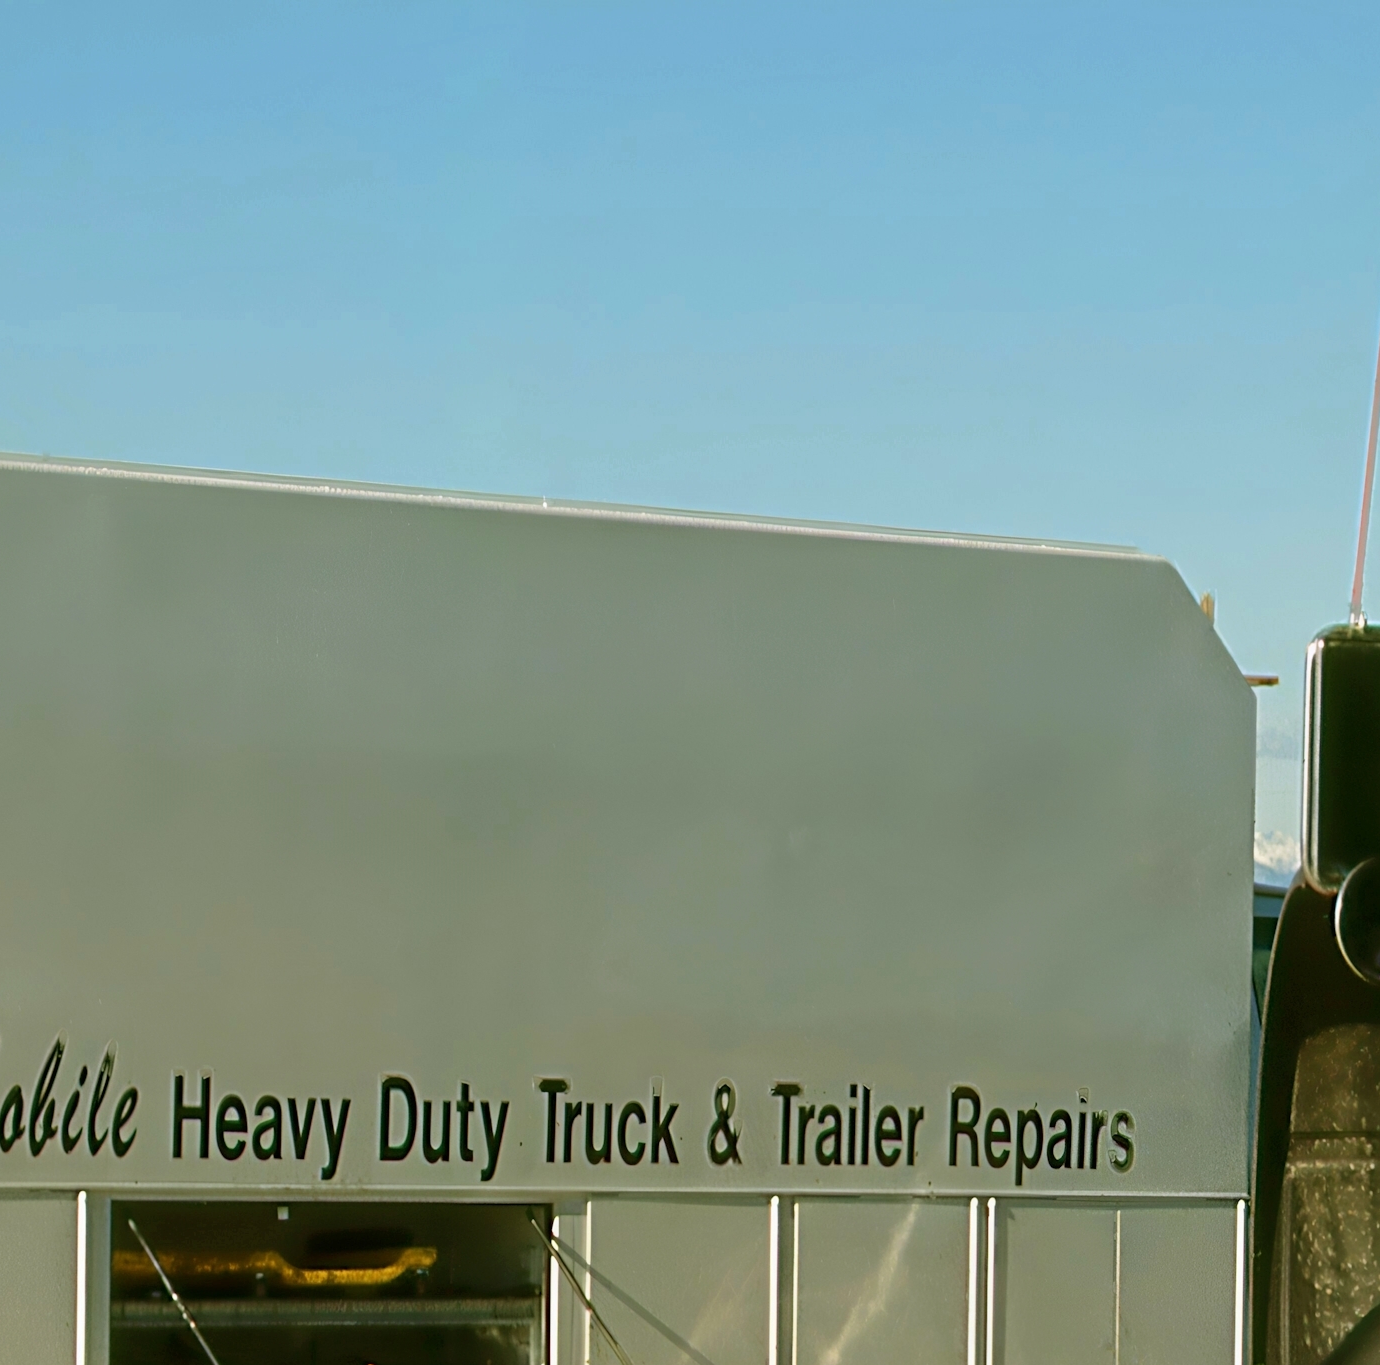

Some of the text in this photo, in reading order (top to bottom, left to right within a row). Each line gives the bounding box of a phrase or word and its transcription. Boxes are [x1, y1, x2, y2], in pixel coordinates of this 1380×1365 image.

[171, 1069, 351, 1181] Heavy
[379, 1074, 510, 1182] Duty
[535, 1076, 680, 1166] Truck
[707, 1078, 742, 1167] &
[770, 1083, 924, 1167] Trailer
[949, 1084, 1135, 1186] Repairs
